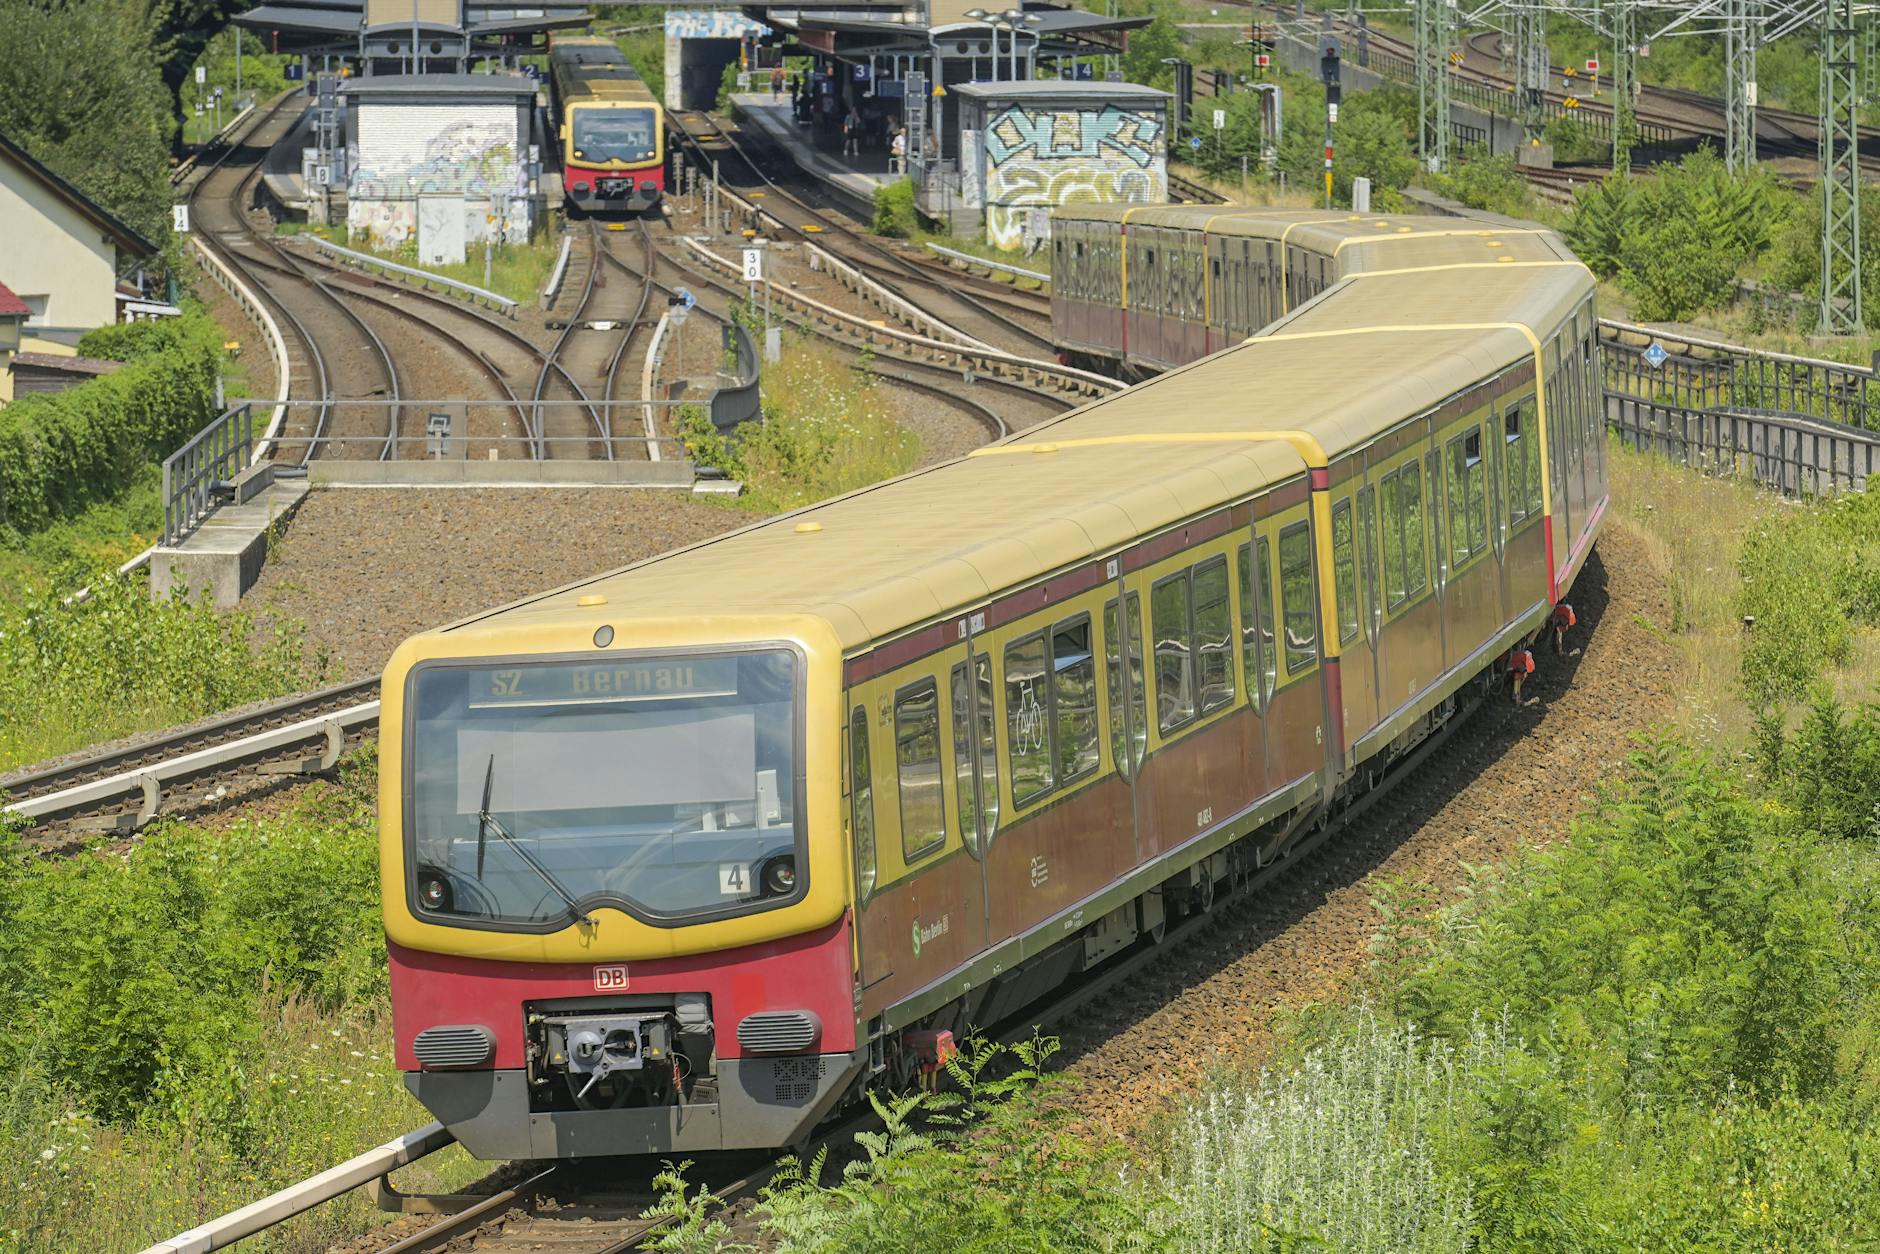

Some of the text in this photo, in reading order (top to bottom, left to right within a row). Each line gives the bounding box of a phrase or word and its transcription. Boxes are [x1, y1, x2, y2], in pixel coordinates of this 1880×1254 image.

[525, 65, 535, 78] 2
[855, 65, 865, 78] 3
[1082, 65, 1092, 77] 4
[319, 168, 326, 182] 8
[572, 666, 696, 694] Bernau
[727, 864, 743, 890] 4
[597, 968, 625, 987] DB
